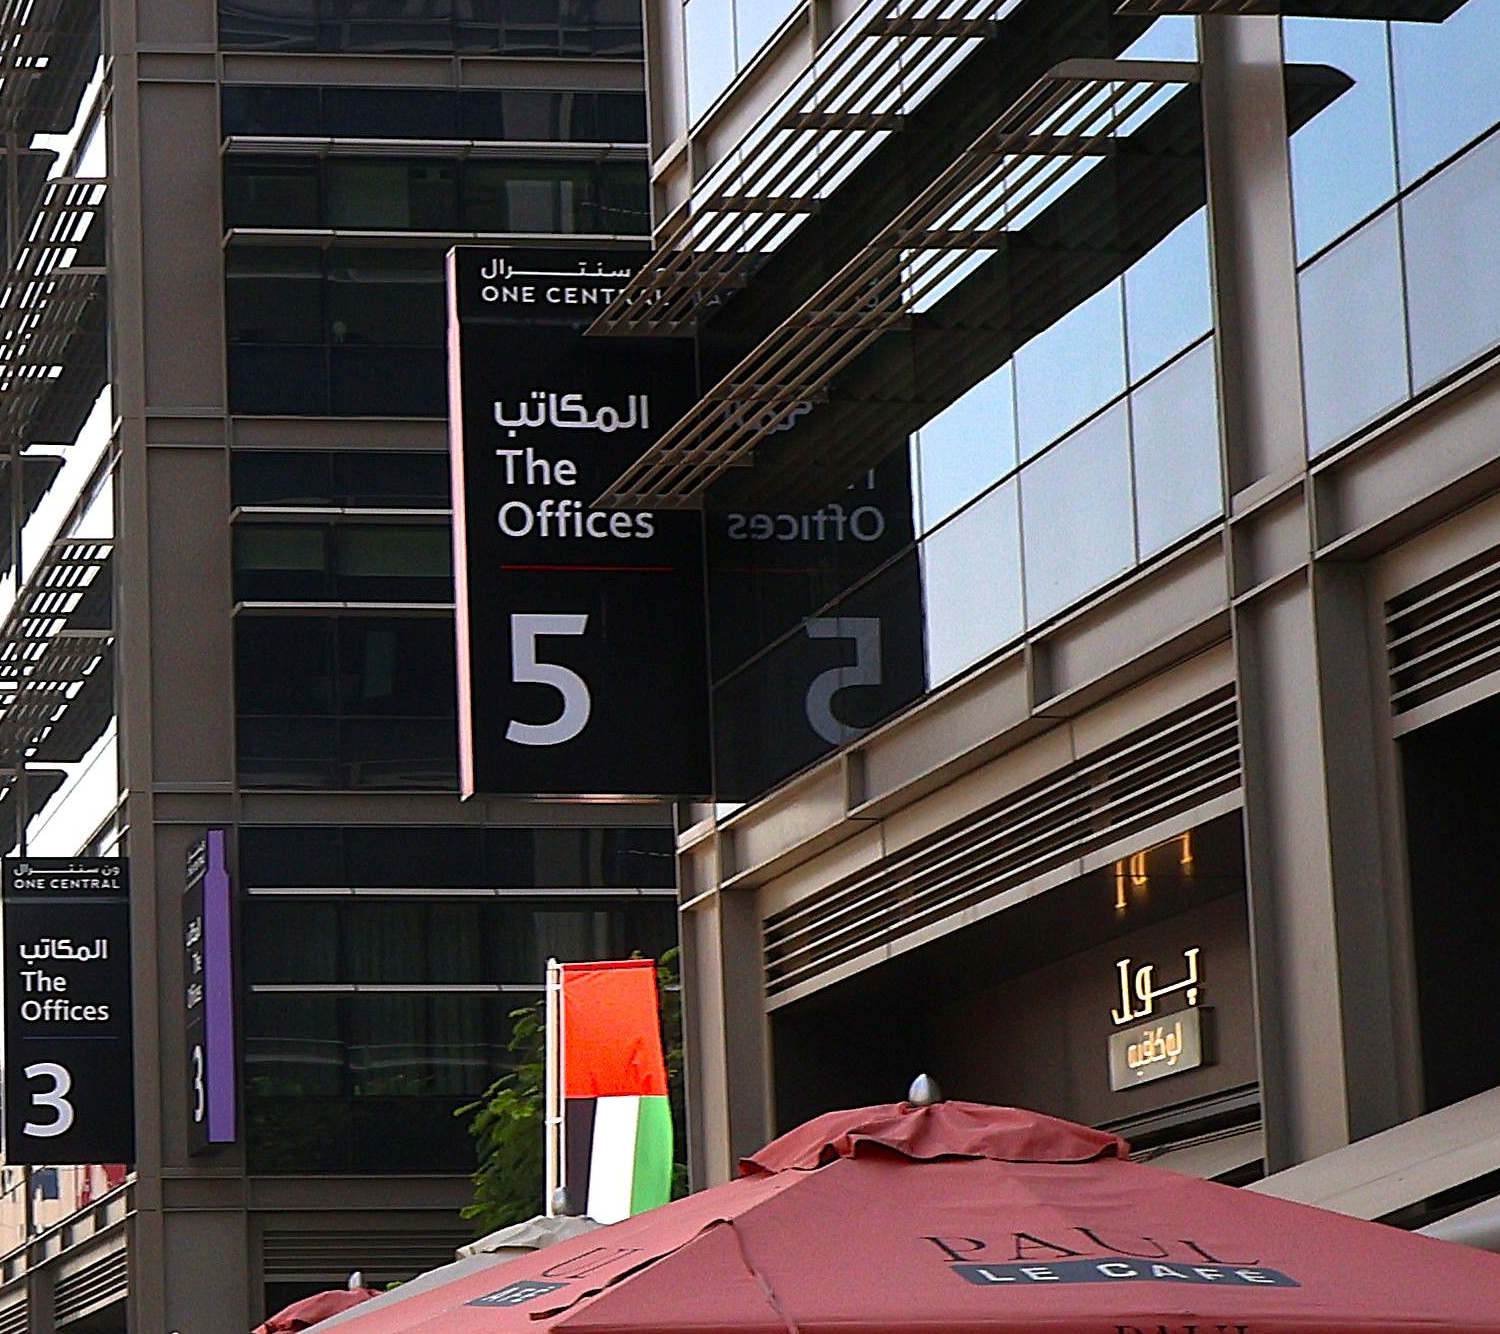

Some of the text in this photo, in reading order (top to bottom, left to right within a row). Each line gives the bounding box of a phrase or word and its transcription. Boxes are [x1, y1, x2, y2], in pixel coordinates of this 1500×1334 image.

[480, 284, 536, 304] ONE
[493, 393, 649, 437] المكاتب
[496, 449, 577, 485] The
[498, 501, 655, 539] Offices
[505, 613, 592, 746] 5
[13, 878, 121, 890] ONE CENTRAL
[18, 937, 109, 965] المكاتب
[20, 971, 67, 993] The
[20, 999, 110, 1023] Offices
[22, 1062, 76, 1138] 3
[919, 1226, 1260, 1265] PAUL
[977, 1265, 1059, 1284] LE
